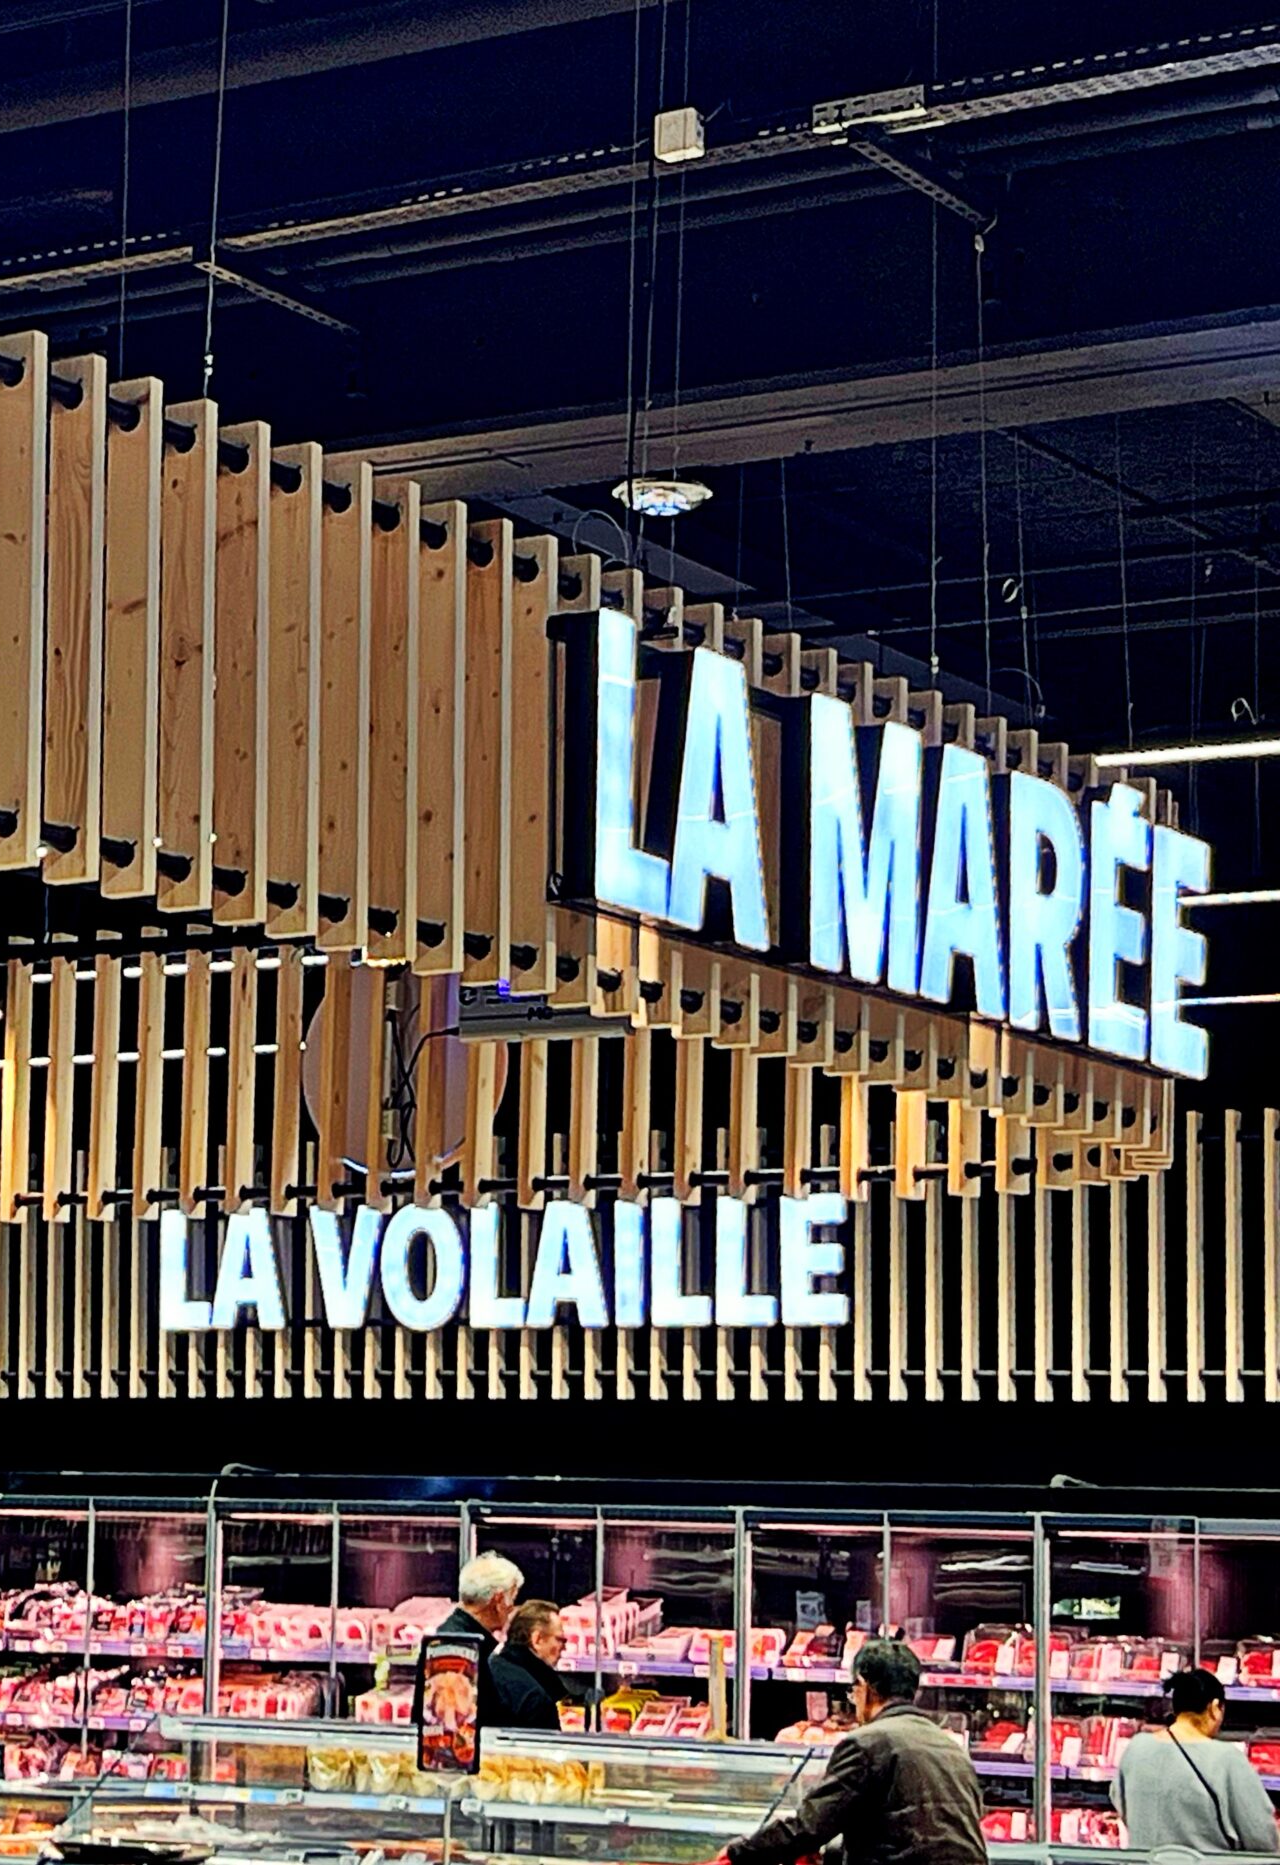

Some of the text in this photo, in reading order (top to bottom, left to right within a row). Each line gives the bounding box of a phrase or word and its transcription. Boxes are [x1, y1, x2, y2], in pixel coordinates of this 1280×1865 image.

[595, 606, 1213, 1081] LA MARÉE
[158, 1192, 850, 1332] LA VOLAILLE
